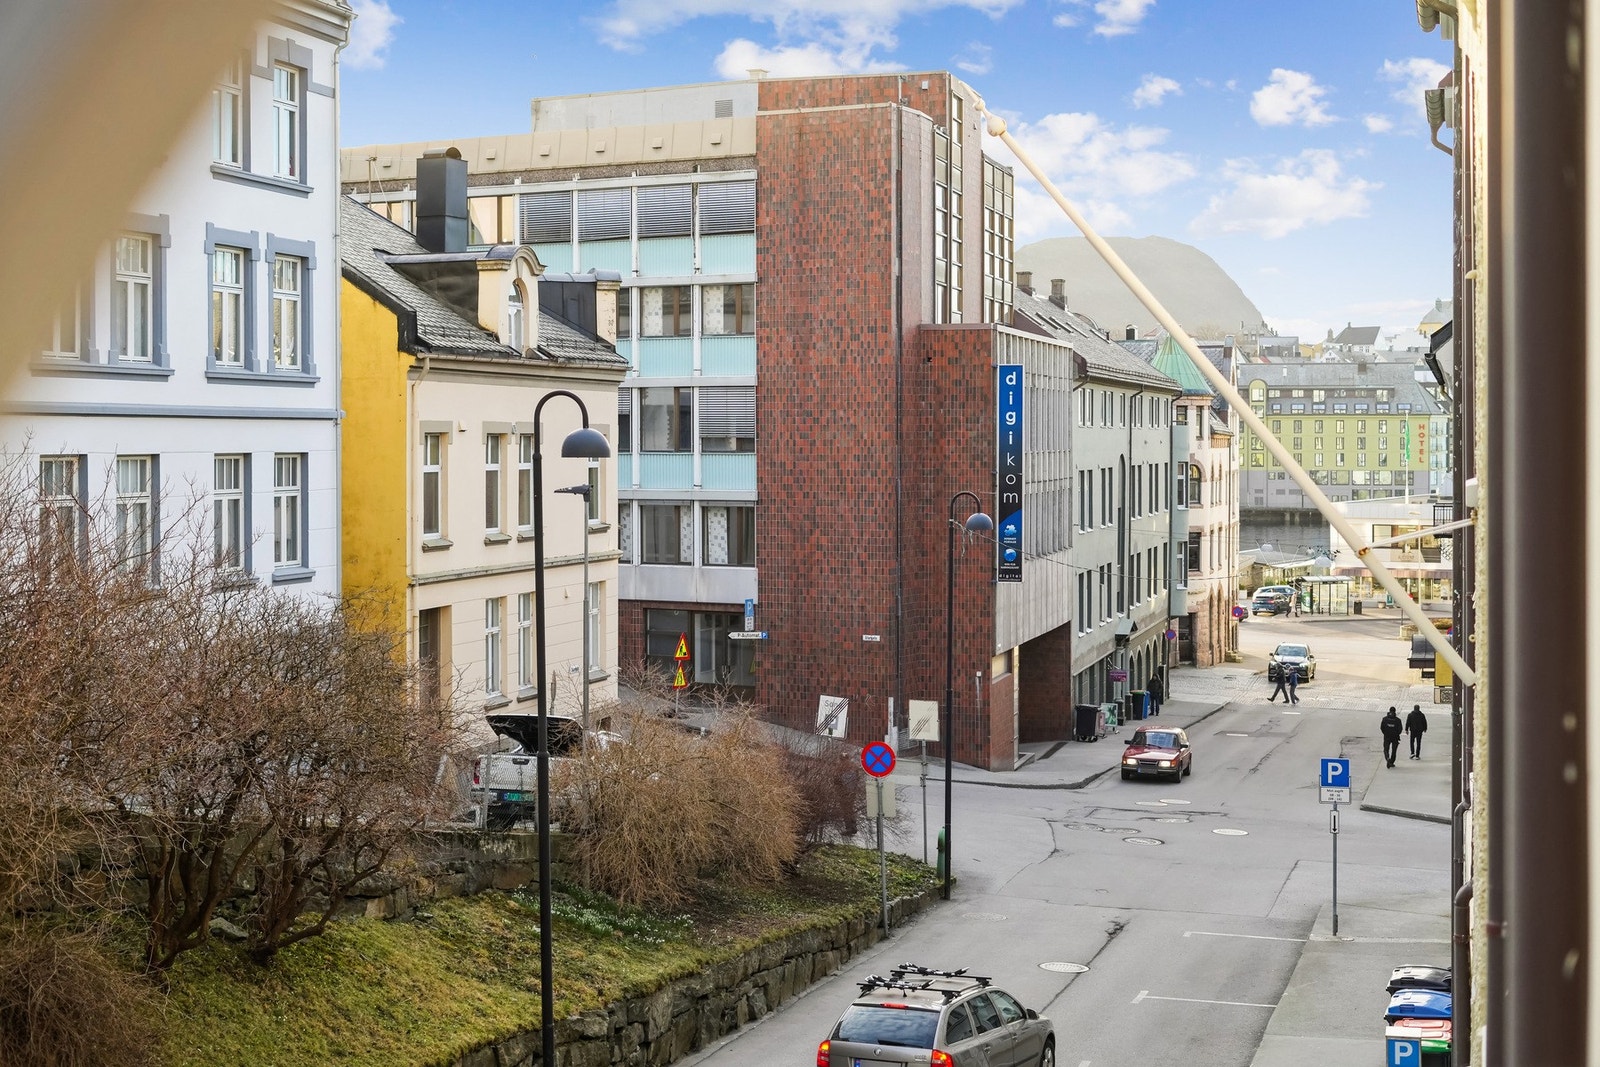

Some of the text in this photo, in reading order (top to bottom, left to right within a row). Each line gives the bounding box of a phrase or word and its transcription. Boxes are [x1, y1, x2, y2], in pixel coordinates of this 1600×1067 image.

[1003, 371, 1018, 503] digikom
[1327, 762, 1343, 784] P
[1394, 1041, 1413, 1065] P
